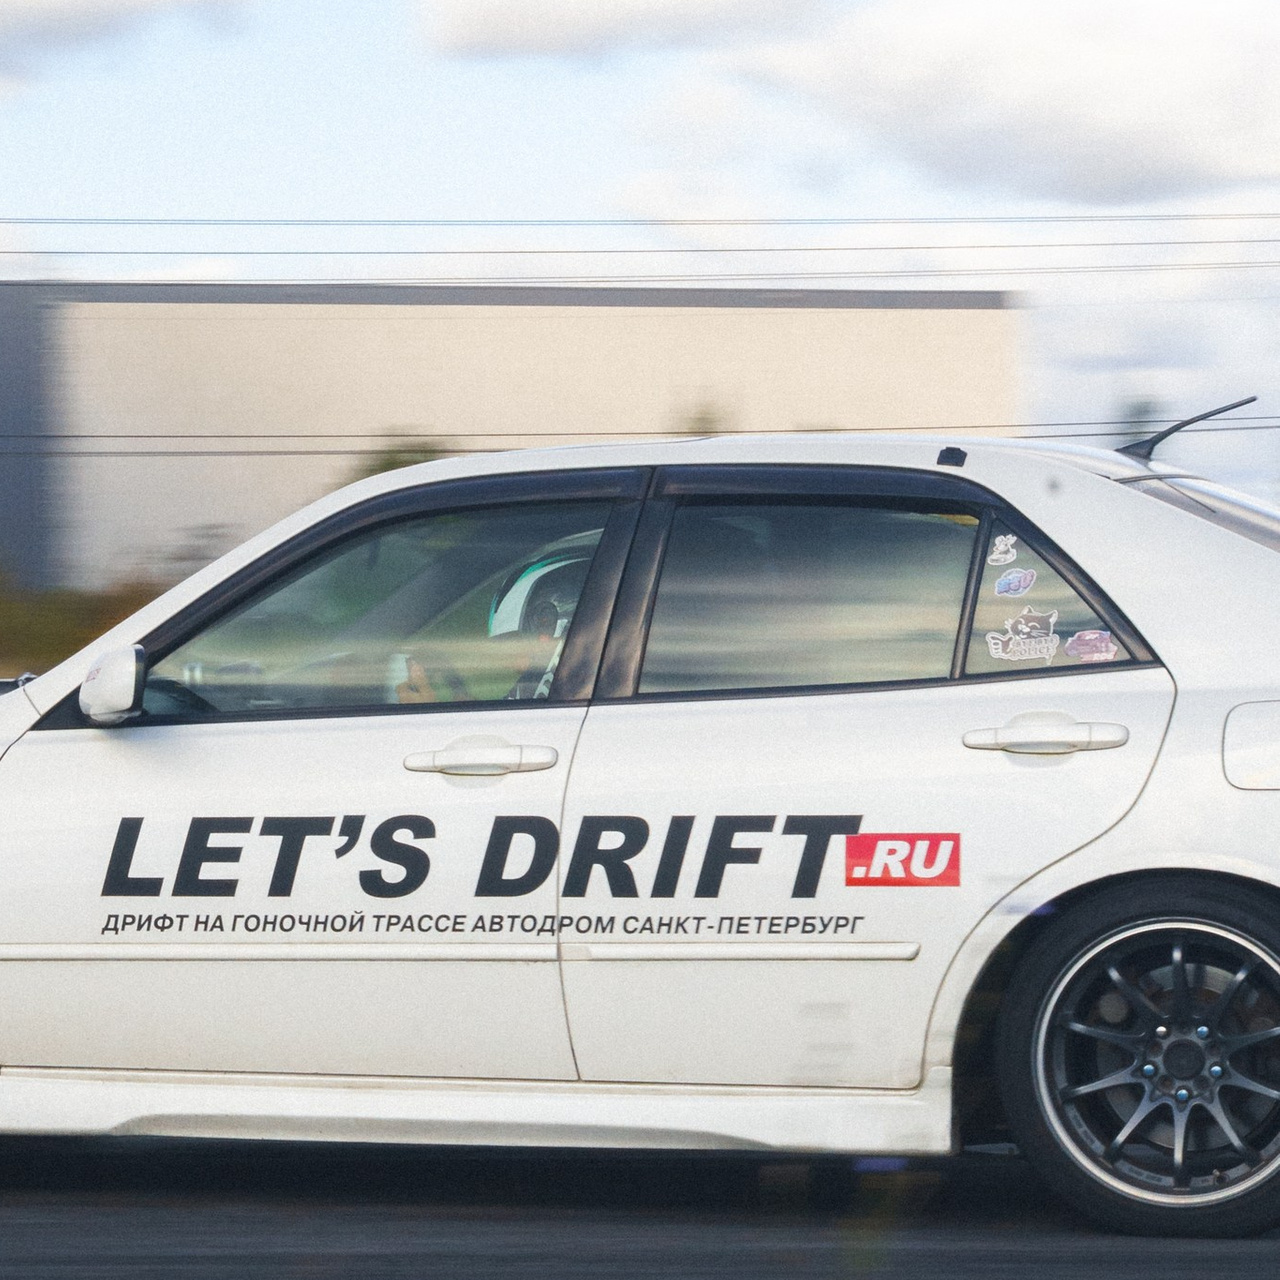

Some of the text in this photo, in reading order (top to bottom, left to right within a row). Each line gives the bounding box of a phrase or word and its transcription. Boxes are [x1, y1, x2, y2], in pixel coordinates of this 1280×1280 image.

[101, 815, 955, 898] LET’S DRIFT .RU
[101, 910, 864, 937] ДРИФТ НА ГОНОЧНОЙ ТРАССЕ АВТОДРОМ САНКТ-ПЕТЕРБУРГ
